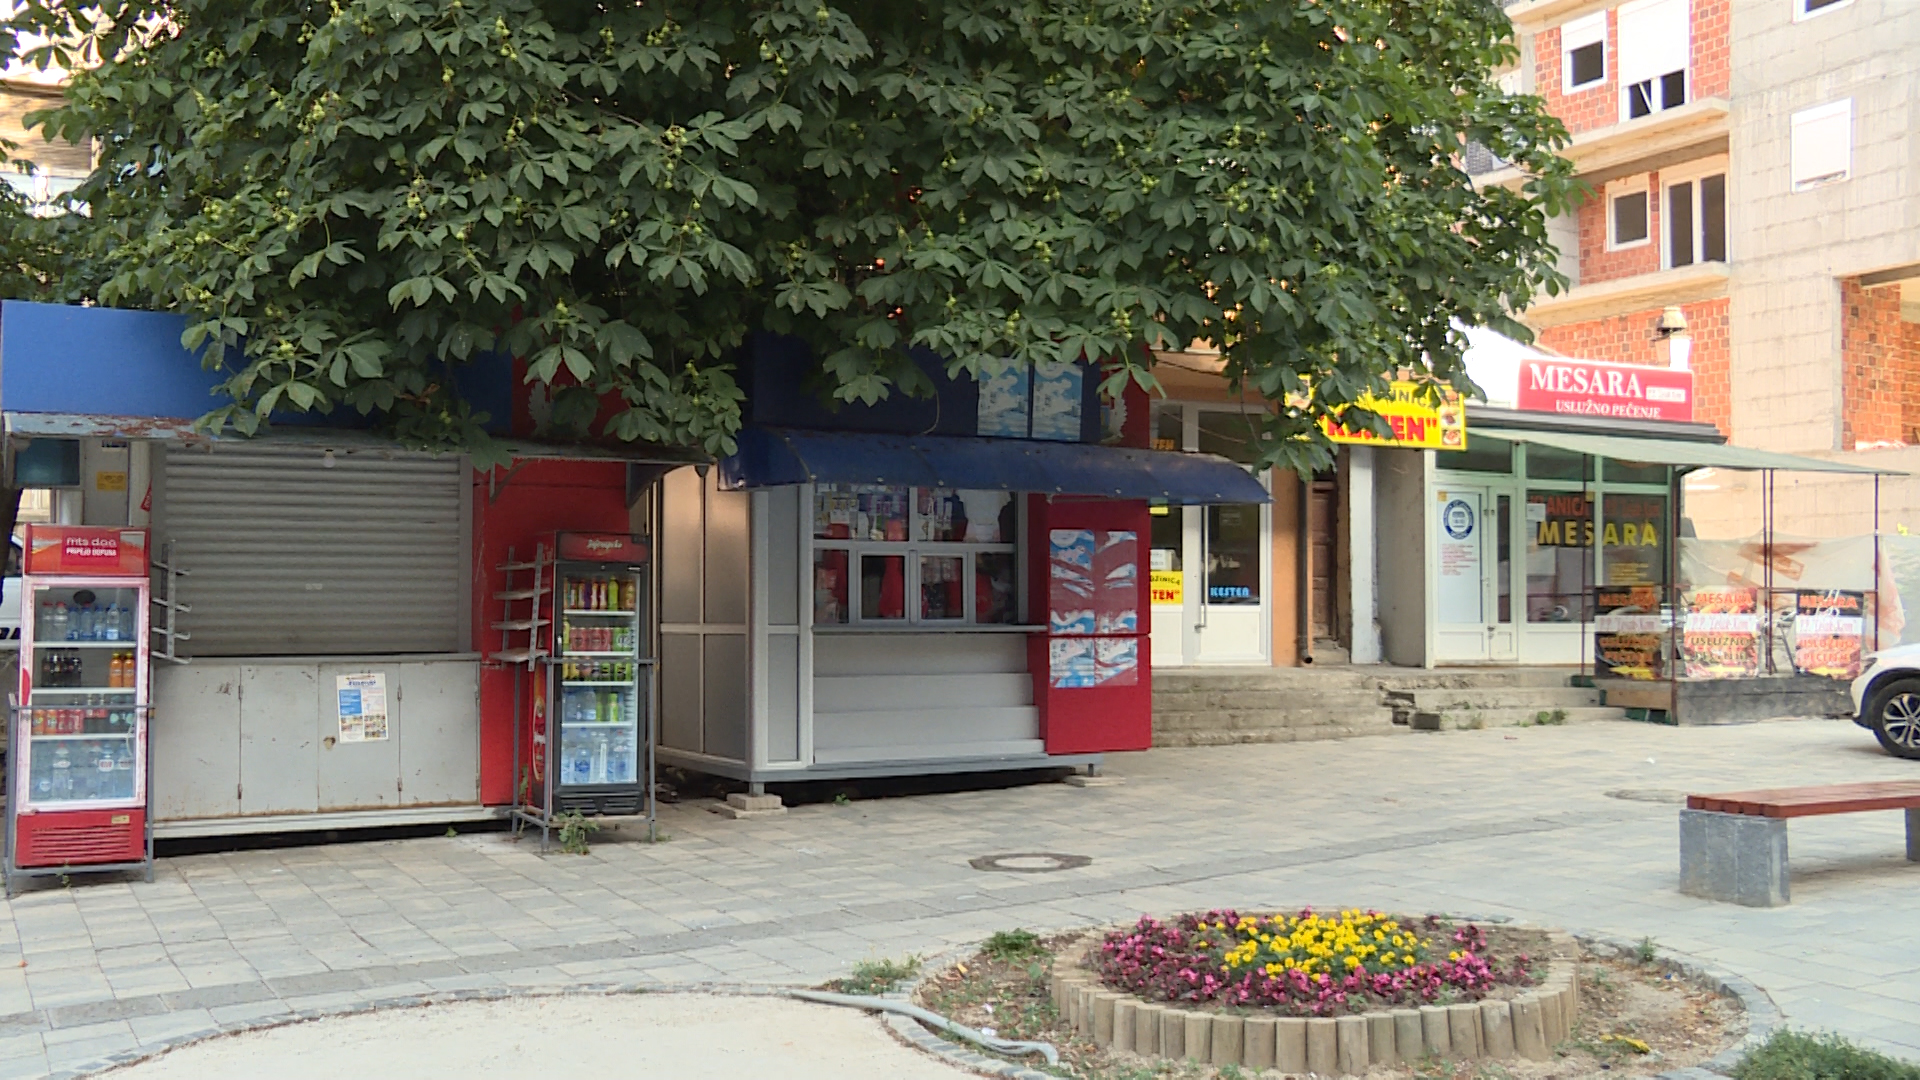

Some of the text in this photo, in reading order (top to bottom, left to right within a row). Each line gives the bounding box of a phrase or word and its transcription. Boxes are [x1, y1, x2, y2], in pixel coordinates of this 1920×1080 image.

[1529, 363, 1643, 398] MESARA
[1556, 399, 1661, 418] USLUŽNO PEČENJE
[1538, 520, 1658, 547] MESARA
[1695, 592, 1753, 604] MESARA
